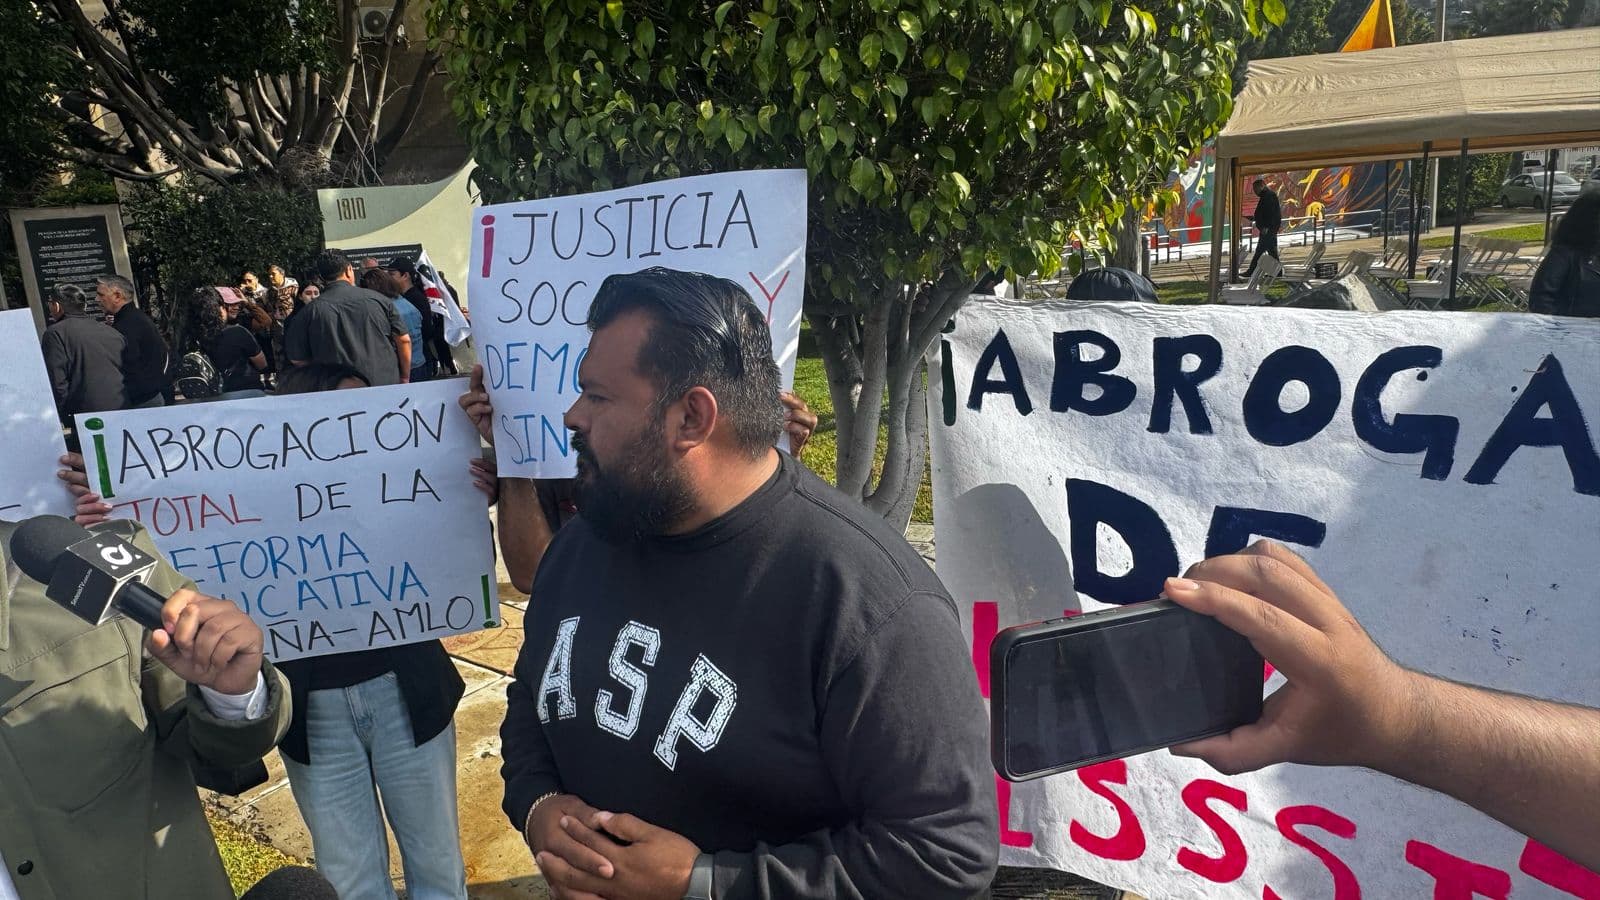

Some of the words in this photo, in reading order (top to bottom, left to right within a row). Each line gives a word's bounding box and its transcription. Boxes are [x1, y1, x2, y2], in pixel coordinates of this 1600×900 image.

[481, 189, 759, 278] ¡JUSTICIA
[497, 278, 590, 326] SOC
[748, 270, 790, 326] Y
[84, 397, 447, 499] ¡ABROGACIÓN
[112, 493, 262, 536] TOTAL
[294, 481, 353, 522] DE
[381, 467, 442, 504] LA
[168, 531, 370, 583] EFORMA
[536, 615, 738, 772] ASP
